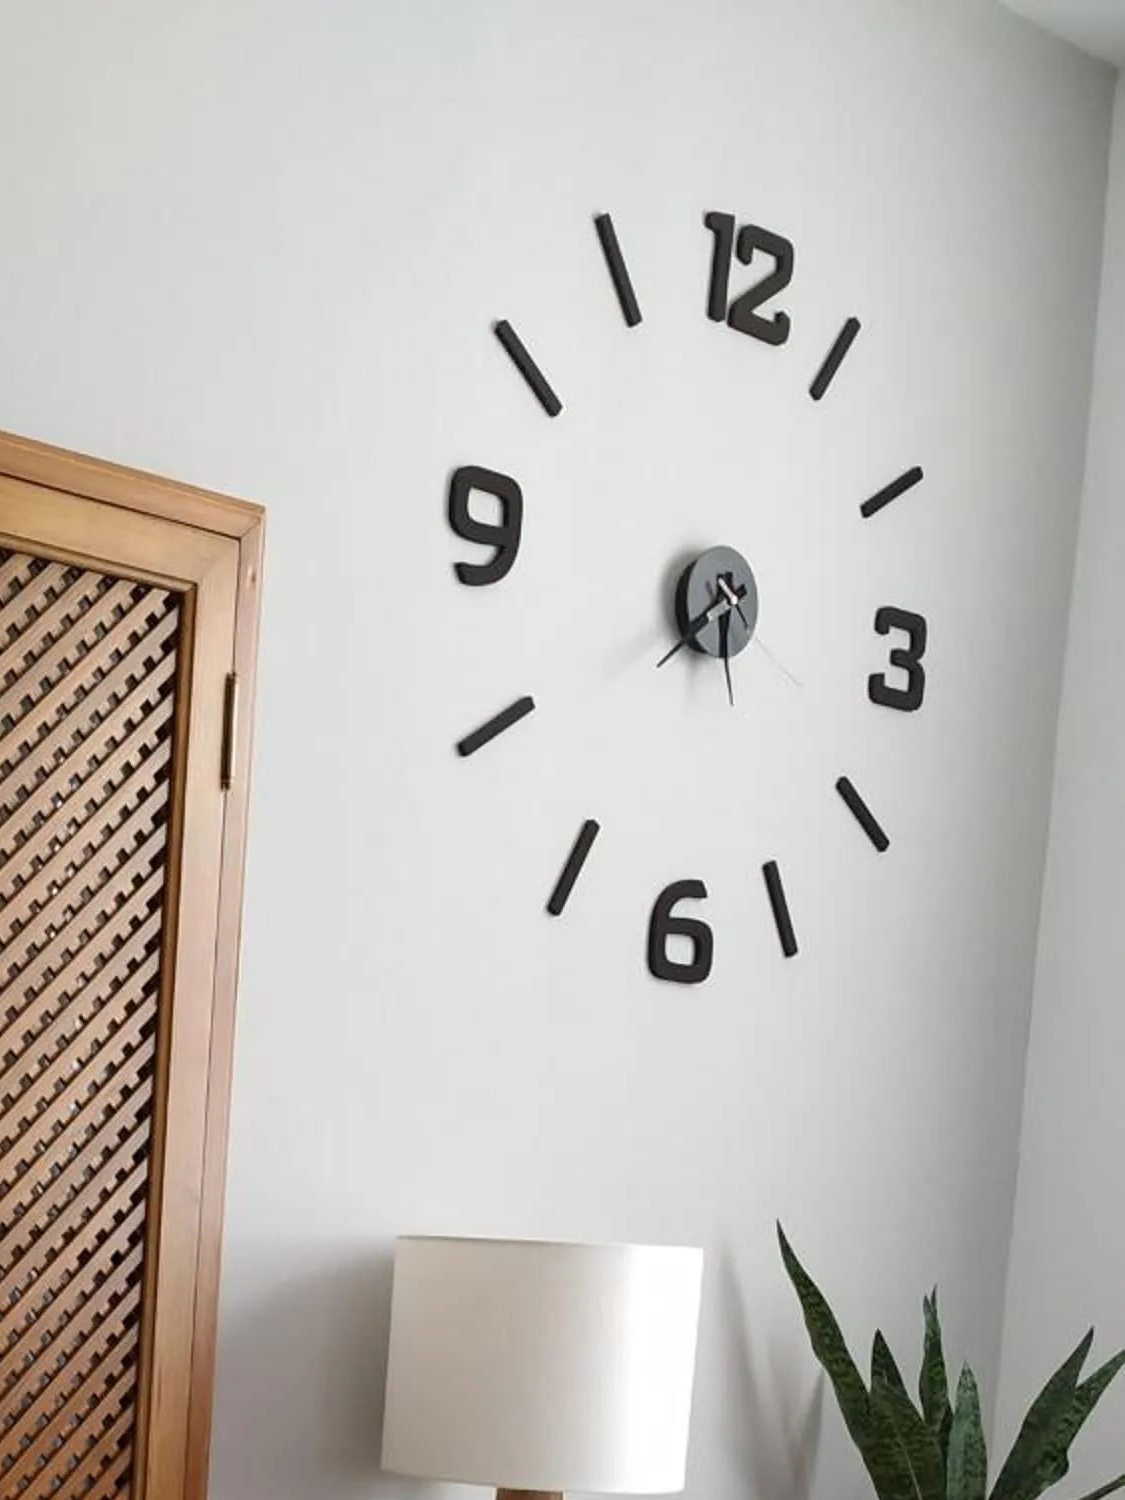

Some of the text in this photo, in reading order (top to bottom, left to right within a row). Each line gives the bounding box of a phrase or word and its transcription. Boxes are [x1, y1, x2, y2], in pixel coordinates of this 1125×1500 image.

[704, 211, 794, 346] 12
[447, 464, 524, 587] 9
[868, 606, 928, 712] 3
[647, 879, 714, 985] 6
